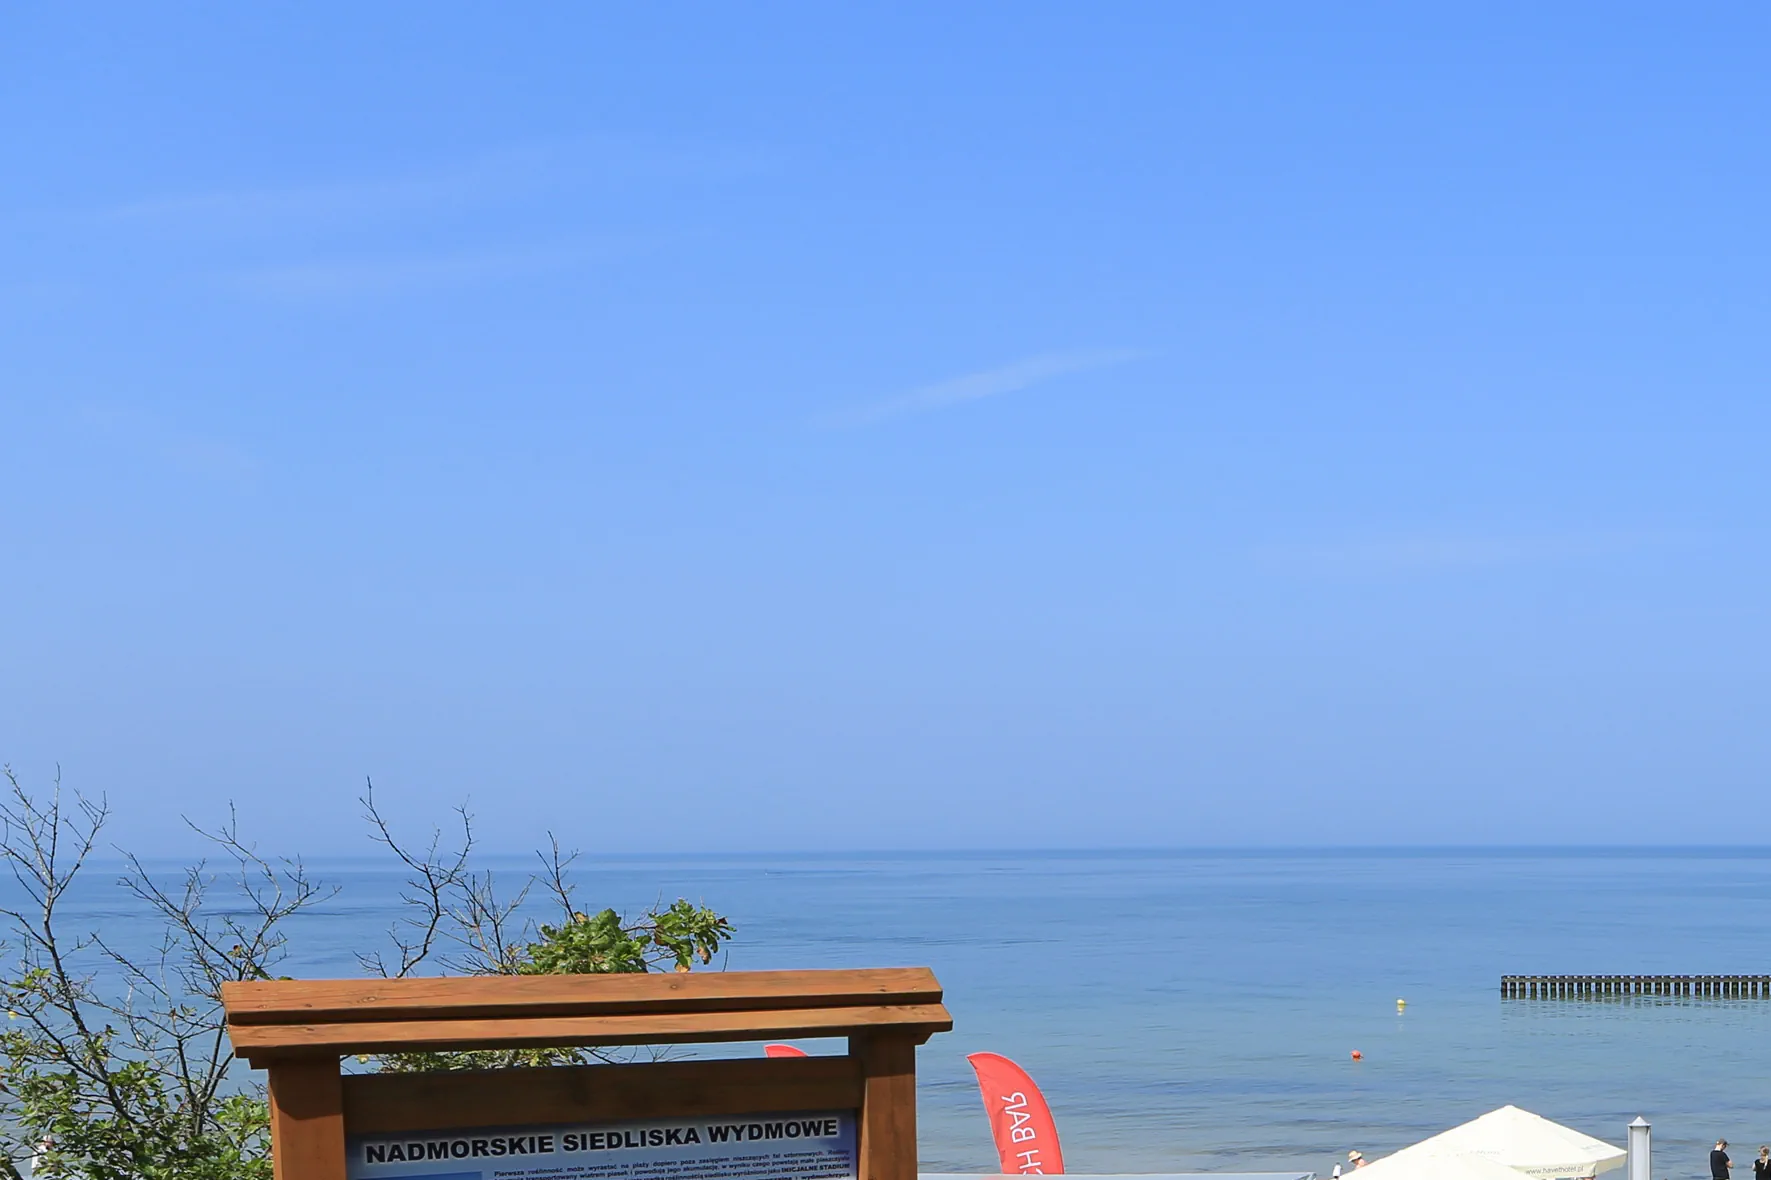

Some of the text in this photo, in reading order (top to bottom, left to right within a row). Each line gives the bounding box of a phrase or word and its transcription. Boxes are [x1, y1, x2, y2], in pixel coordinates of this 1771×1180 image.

[366, 1119, 838, 1164] NADMORSKIE SIEDLISKA WYDMOWE
[1525, 1165, 1584, 1175] www.havethotel.pl
